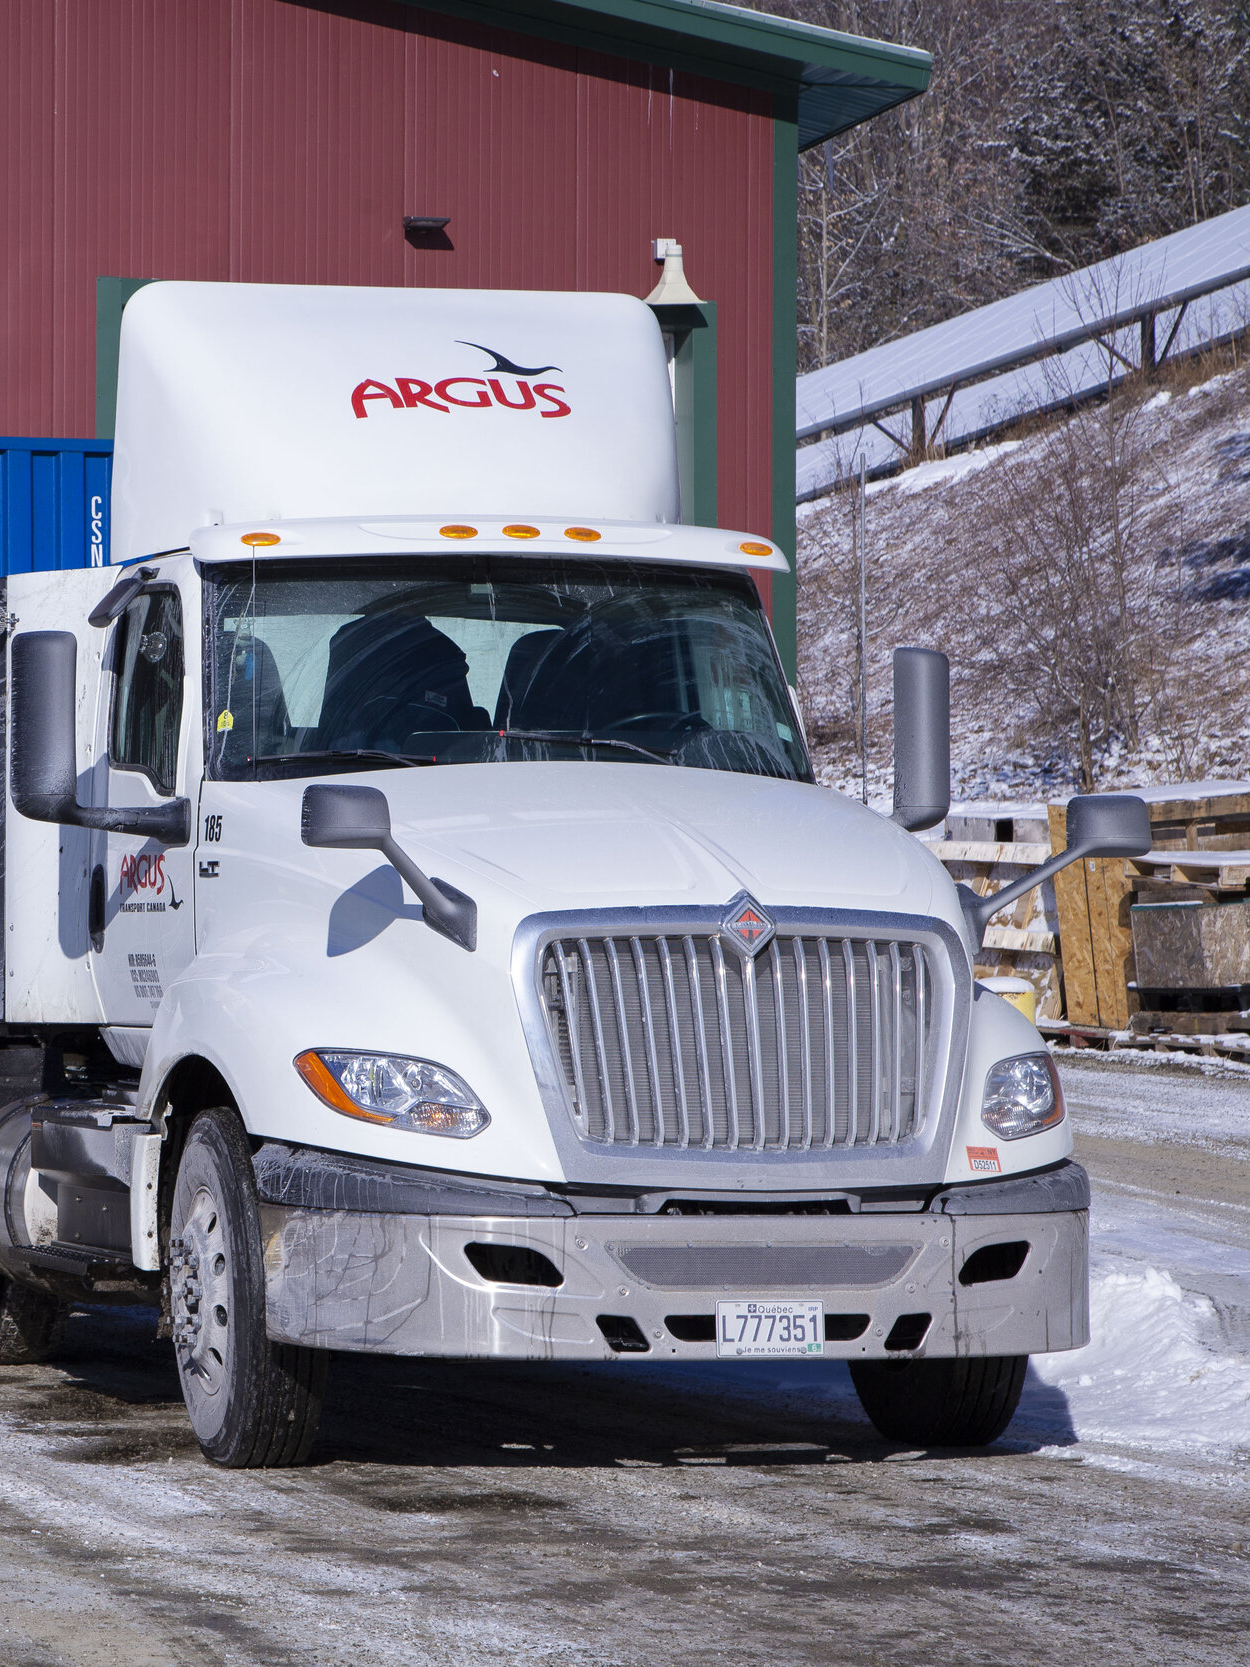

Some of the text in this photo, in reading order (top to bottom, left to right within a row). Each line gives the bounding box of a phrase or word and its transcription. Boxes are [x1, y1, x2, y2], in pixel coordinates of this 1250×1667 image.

[351, 377, 571, 419] ARGUS
[204, 815, 223, 842] 185
[119, 854, 165, 896] ARGUS
[119, 902, 166, 913] TRANSPORT CANADA
[973, 1160, 997, 1170] D52511
[758, 1304, 793, 1313] Québec
[721, 1315, 818, 1342] L777351
[811, 1344, 817, 1352] 6
